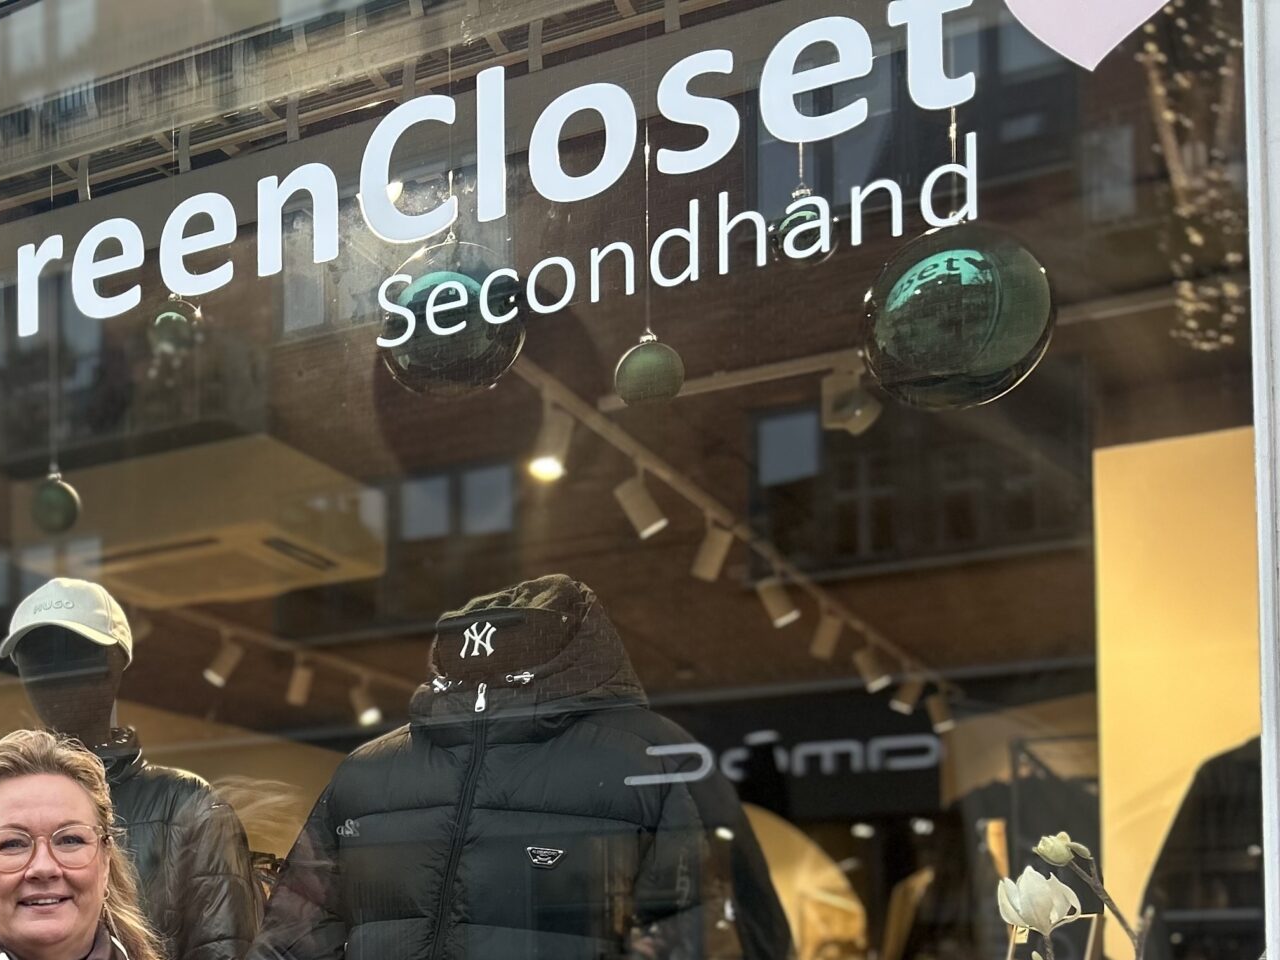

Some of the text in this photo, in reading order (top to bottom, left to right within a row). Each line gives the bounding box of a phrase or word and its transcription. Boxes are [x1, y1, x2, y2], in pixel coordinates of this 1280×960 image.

[376, 131, 979, 348] Secondhand
[33, 600, 75, 615] HUGO
[459, 621, 497, 659] NY
